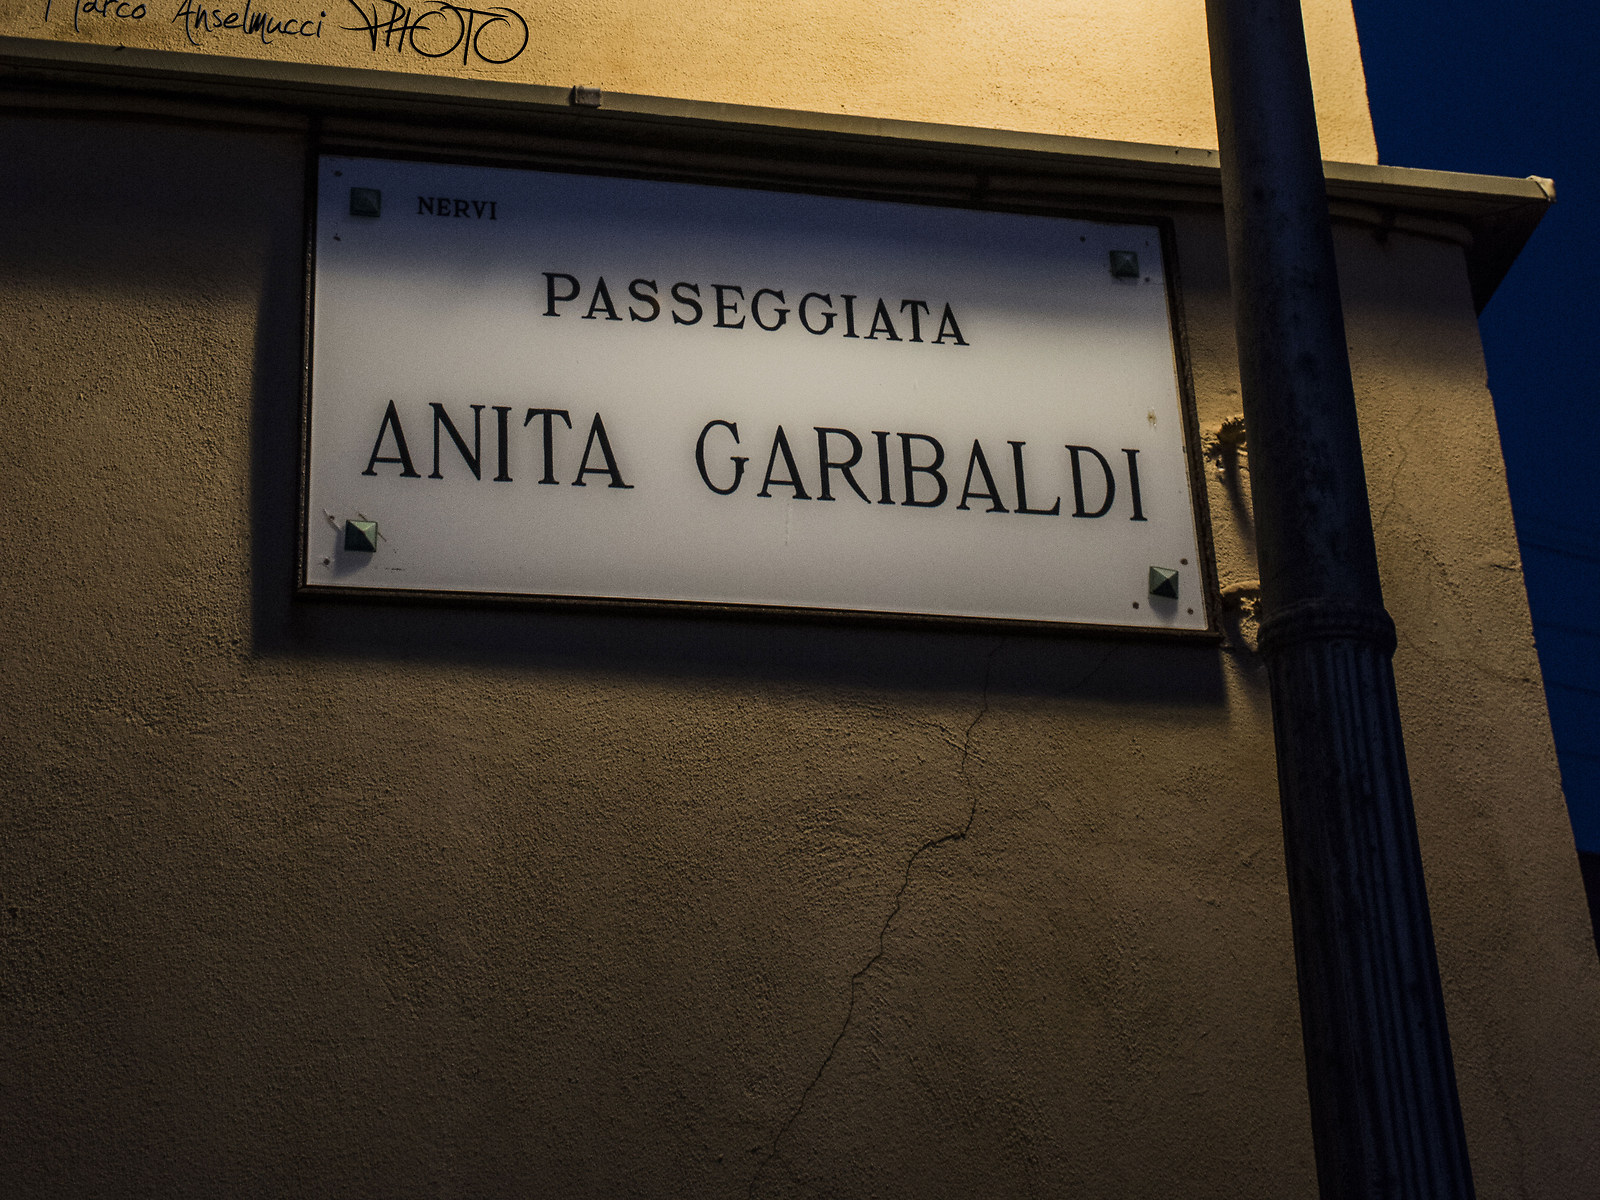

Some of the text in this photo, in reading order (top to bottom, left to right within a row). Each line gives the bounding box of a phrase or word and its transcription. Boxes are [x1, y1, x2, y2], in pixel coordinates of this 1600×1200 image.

[416, 196, 498, 221] NERVI
[541, 272, 970, 346] PASSEGGIATA
[361, 399, 1148, 522] ANITA GARIBALDI
